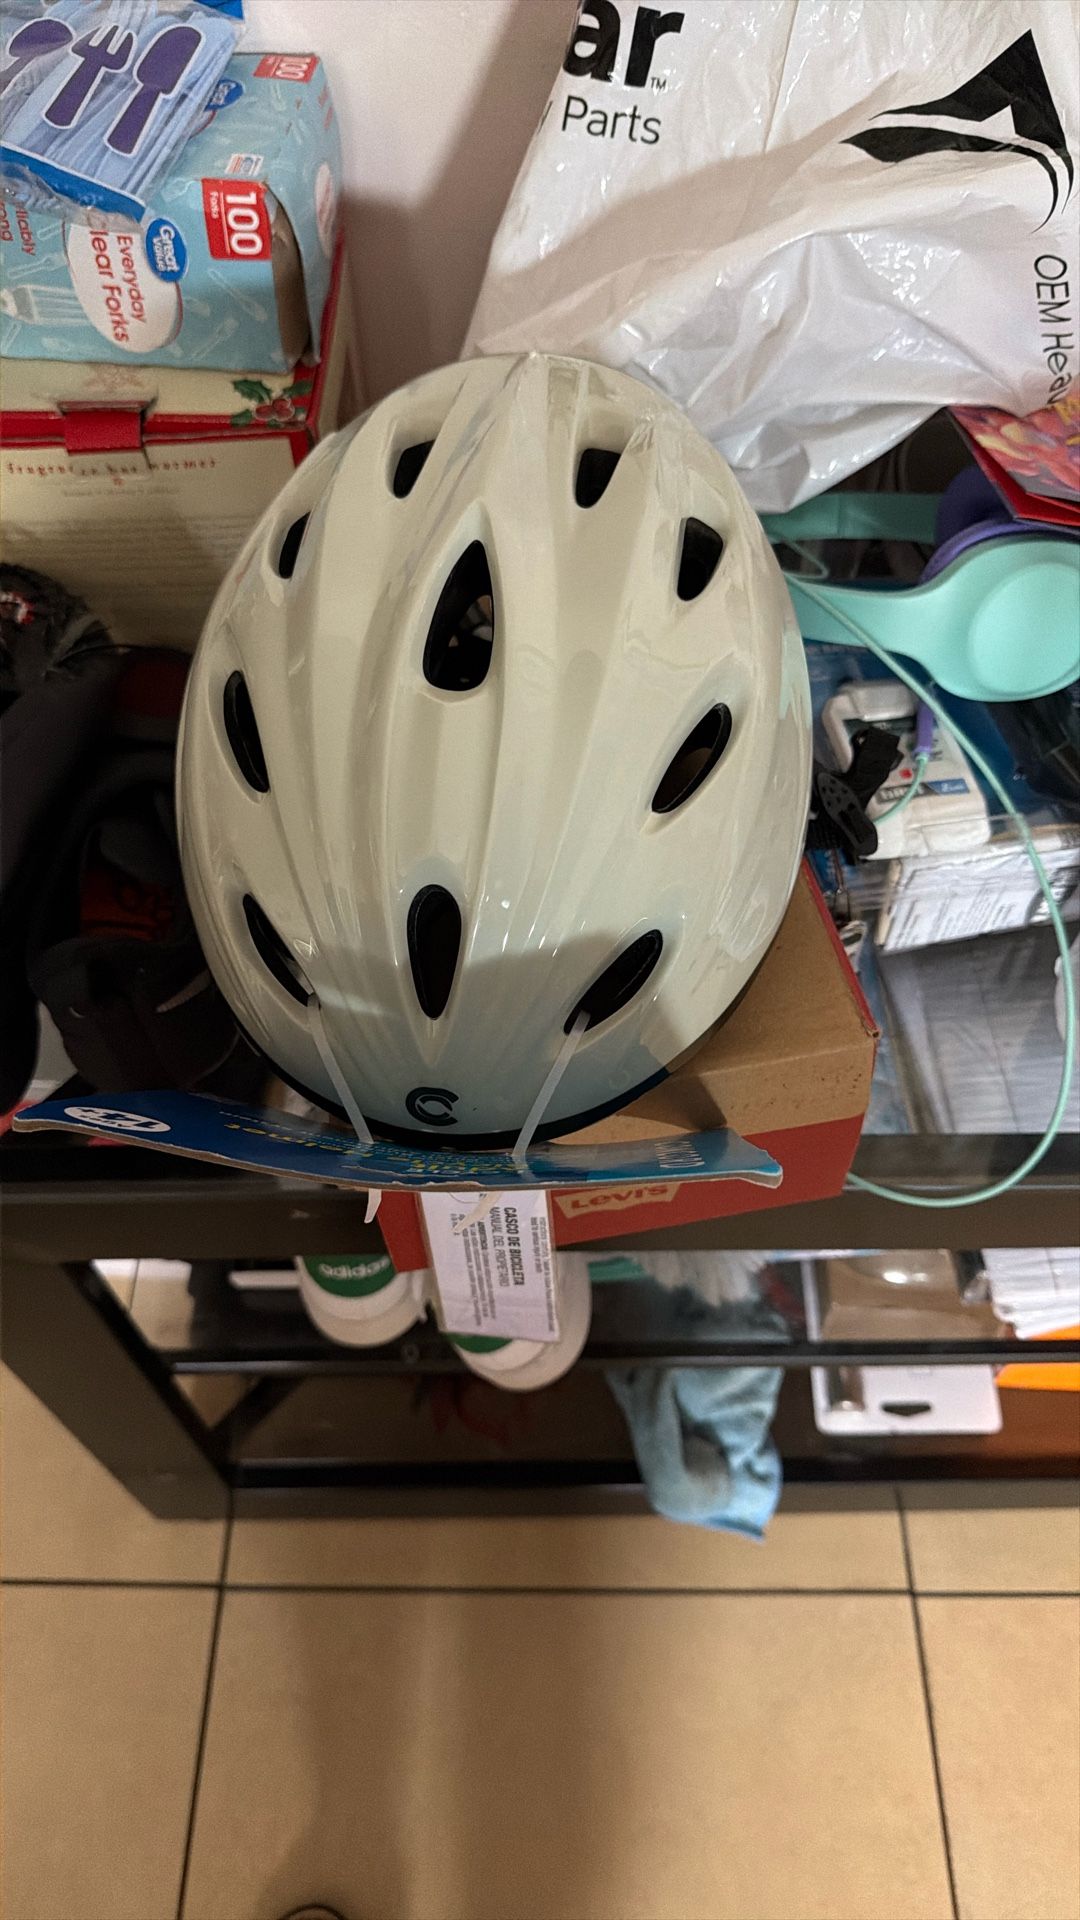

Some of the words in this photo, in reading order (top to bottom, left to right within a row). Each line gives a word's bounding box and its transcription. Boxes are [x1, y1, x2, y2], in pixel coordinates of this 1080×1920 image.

[561, 95, 662, 145] Parts
[225, 191, 263, 257] 100
[152, 236, 166, 272] Value
[159, 225, 180, 272] Great
[117, 235, 147, 324] Everyday
[1034, 254, 1072, 323] OEM
[102, 284, 130, 342] Forks
[504, 1207, 519, 1235] CASCO
[508, 1236, 521, 1247] DE
[319, 1256, 391, 1280] adidas
[509, 1248, 525, 1286] BICICLETA
